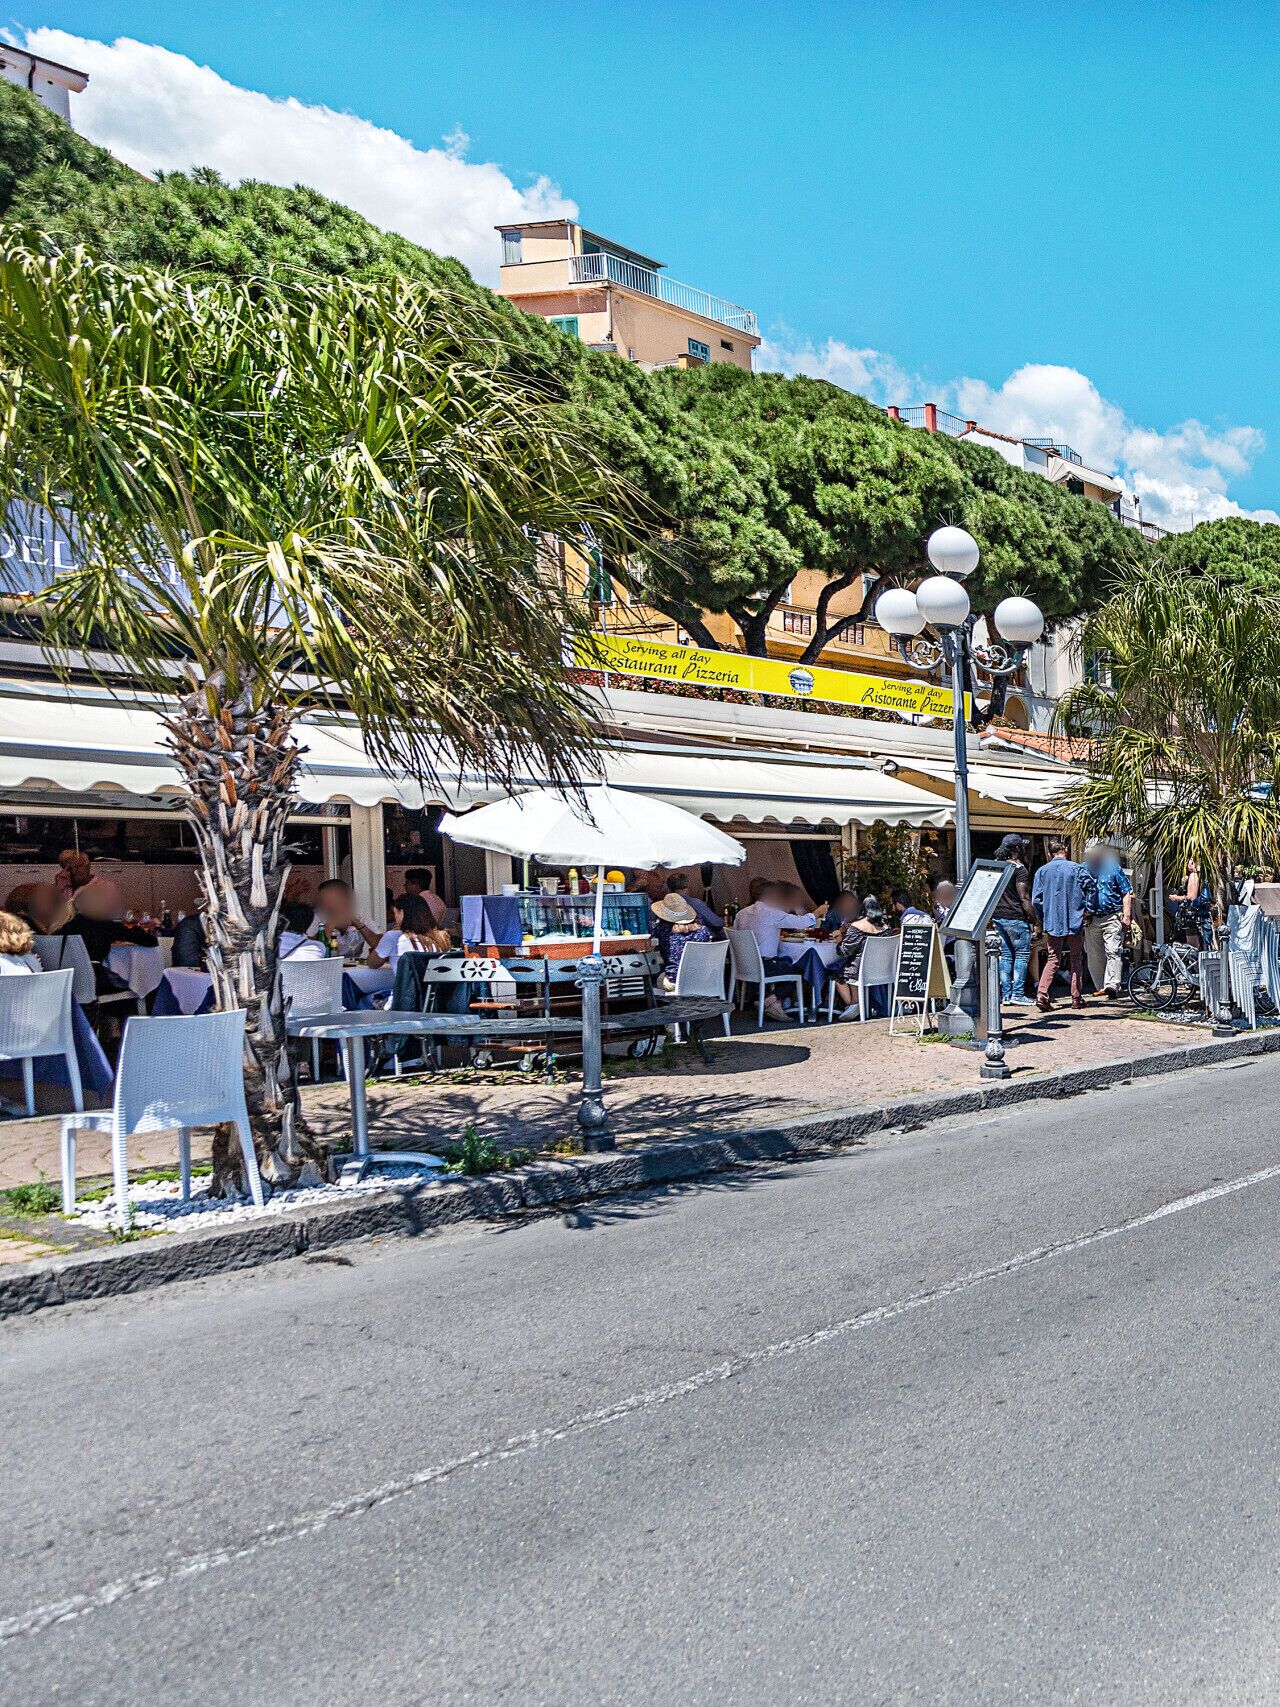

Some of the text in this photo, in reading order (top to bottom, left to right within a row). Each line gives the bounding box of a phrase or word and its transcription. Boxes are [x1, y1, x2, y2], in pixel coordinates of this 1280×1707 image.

[622, 641, 711, 664] Serving all day
[591, 649, 739, 684] Restaurant Pizzeria
[861, 687, 954, 715] Ristorante Pizzer
[881, 680, 943, 699] Serving all day
